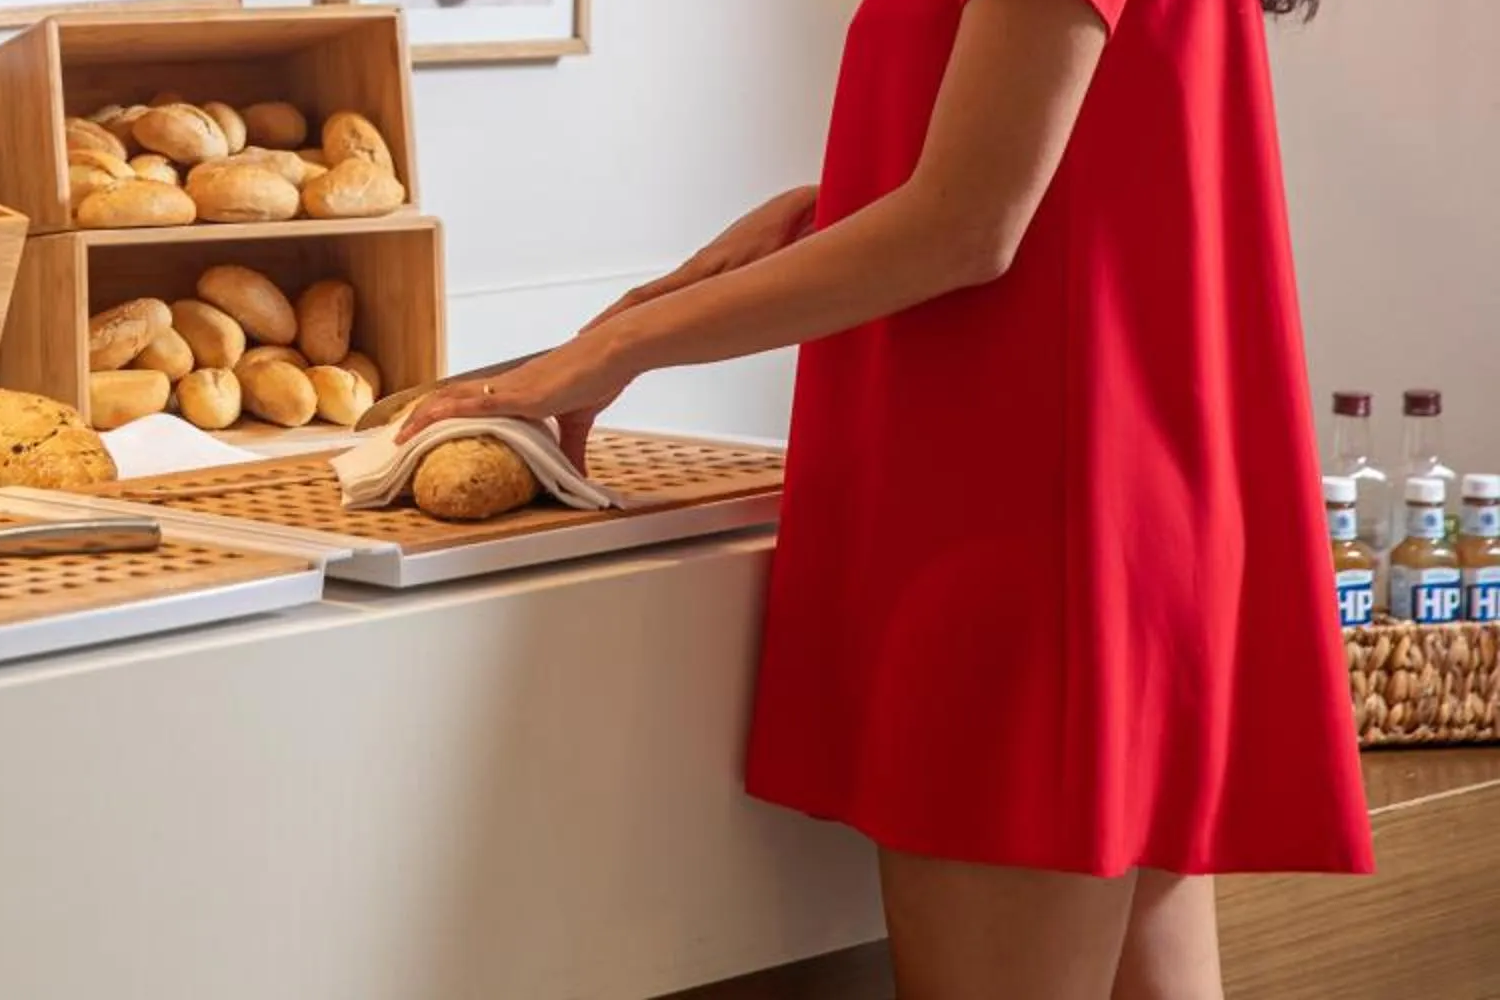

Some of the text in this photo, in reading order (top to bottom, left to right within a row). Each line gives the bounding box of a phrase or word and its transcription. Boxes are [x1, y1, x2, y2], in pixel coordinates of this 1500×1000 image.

[1338, 589, 1373, 621] HP
[1417, 587, 1460, 620] HP
[1472, 587, 1500, 619] H
